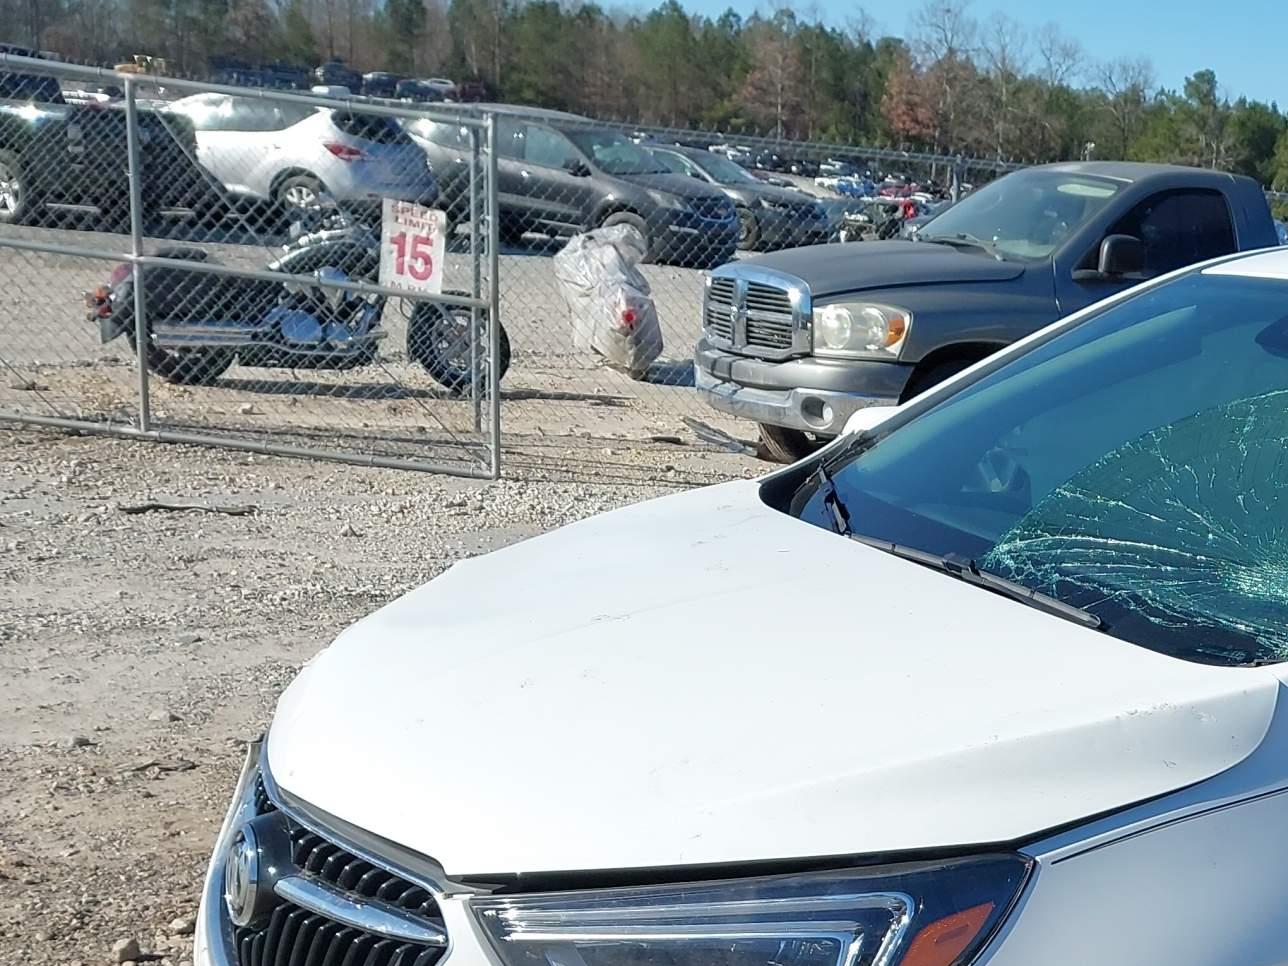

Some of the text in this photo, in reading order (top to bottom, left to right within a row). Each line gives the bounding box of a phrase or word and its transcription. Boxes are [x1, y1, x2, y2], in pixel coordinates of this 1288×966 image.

[392, 203, 439, 222] SPEED
[395, 215, 434, 233] LIMIT
[390, 231, 433, 281] 15
